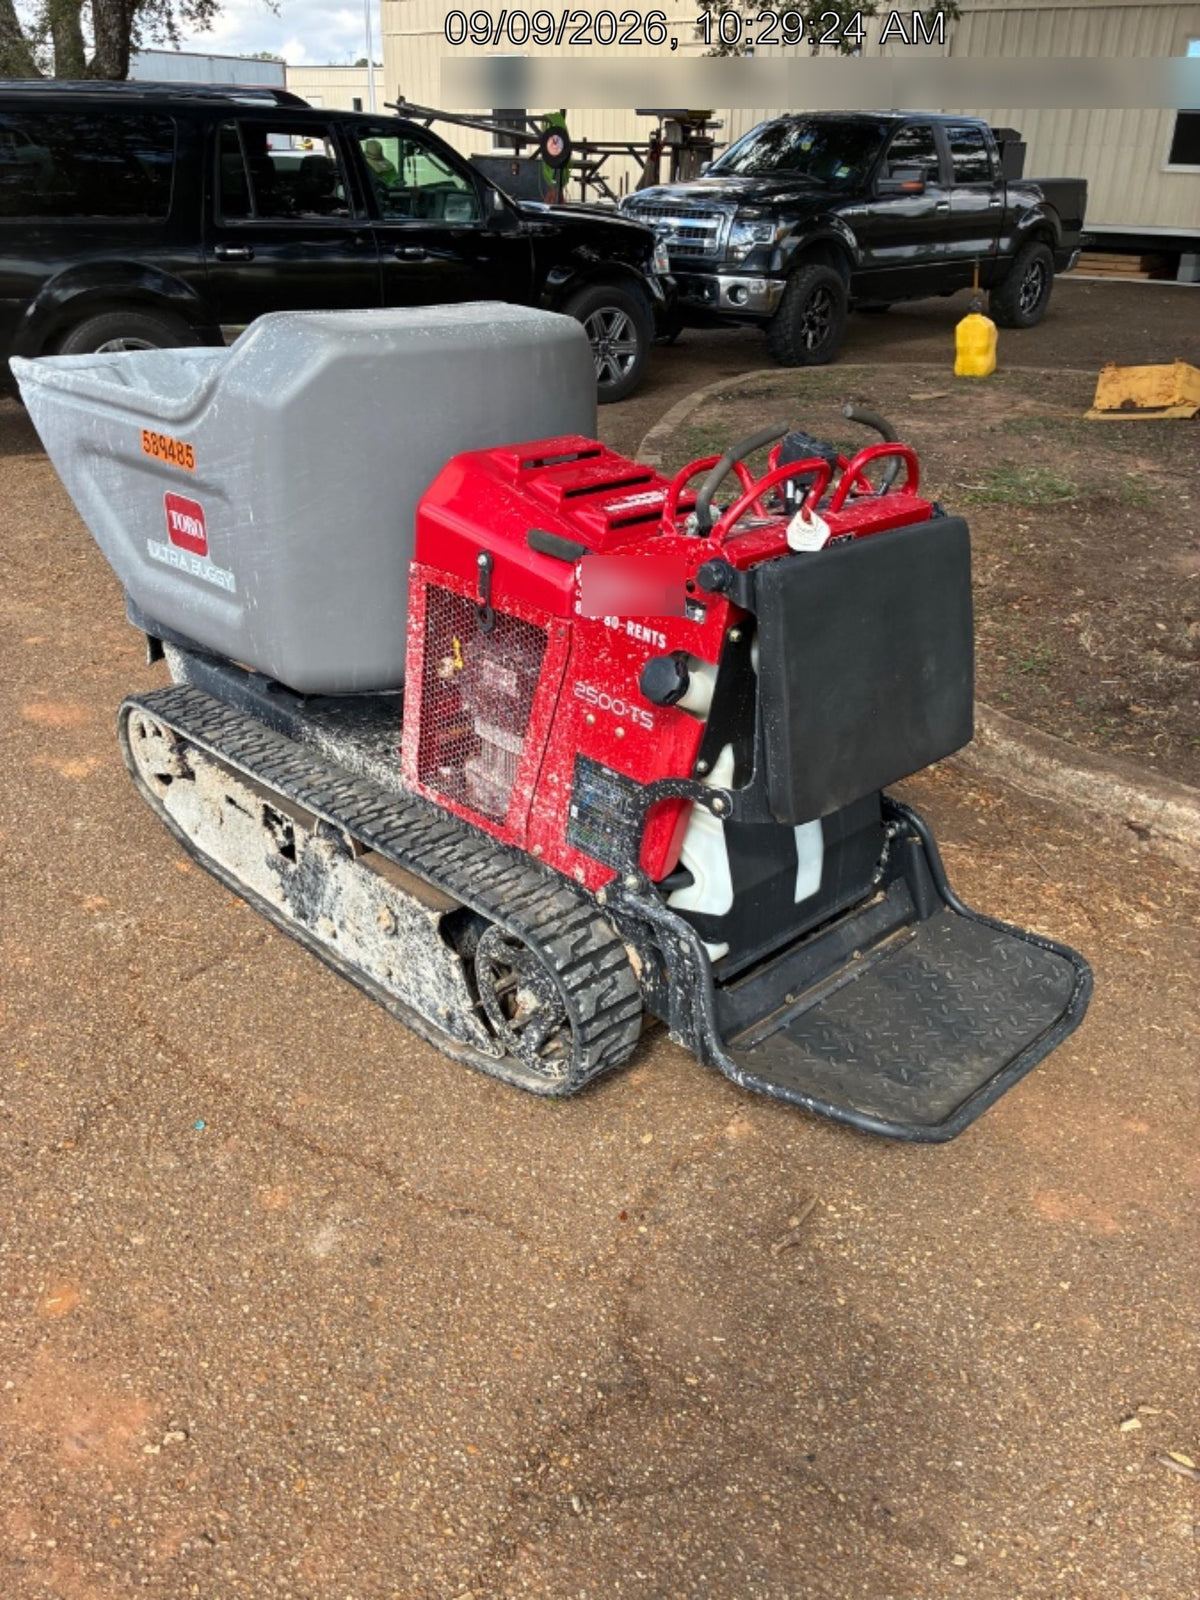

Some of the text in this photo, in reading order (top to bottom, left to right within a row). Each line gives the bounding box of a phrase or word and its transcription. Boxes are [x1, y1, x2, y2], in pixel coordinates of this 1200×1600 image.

[143, 430, 194, 468] 589485
[168, 510, 205, 541] TORO
[574, 682, 654, 730] 2500-TS
